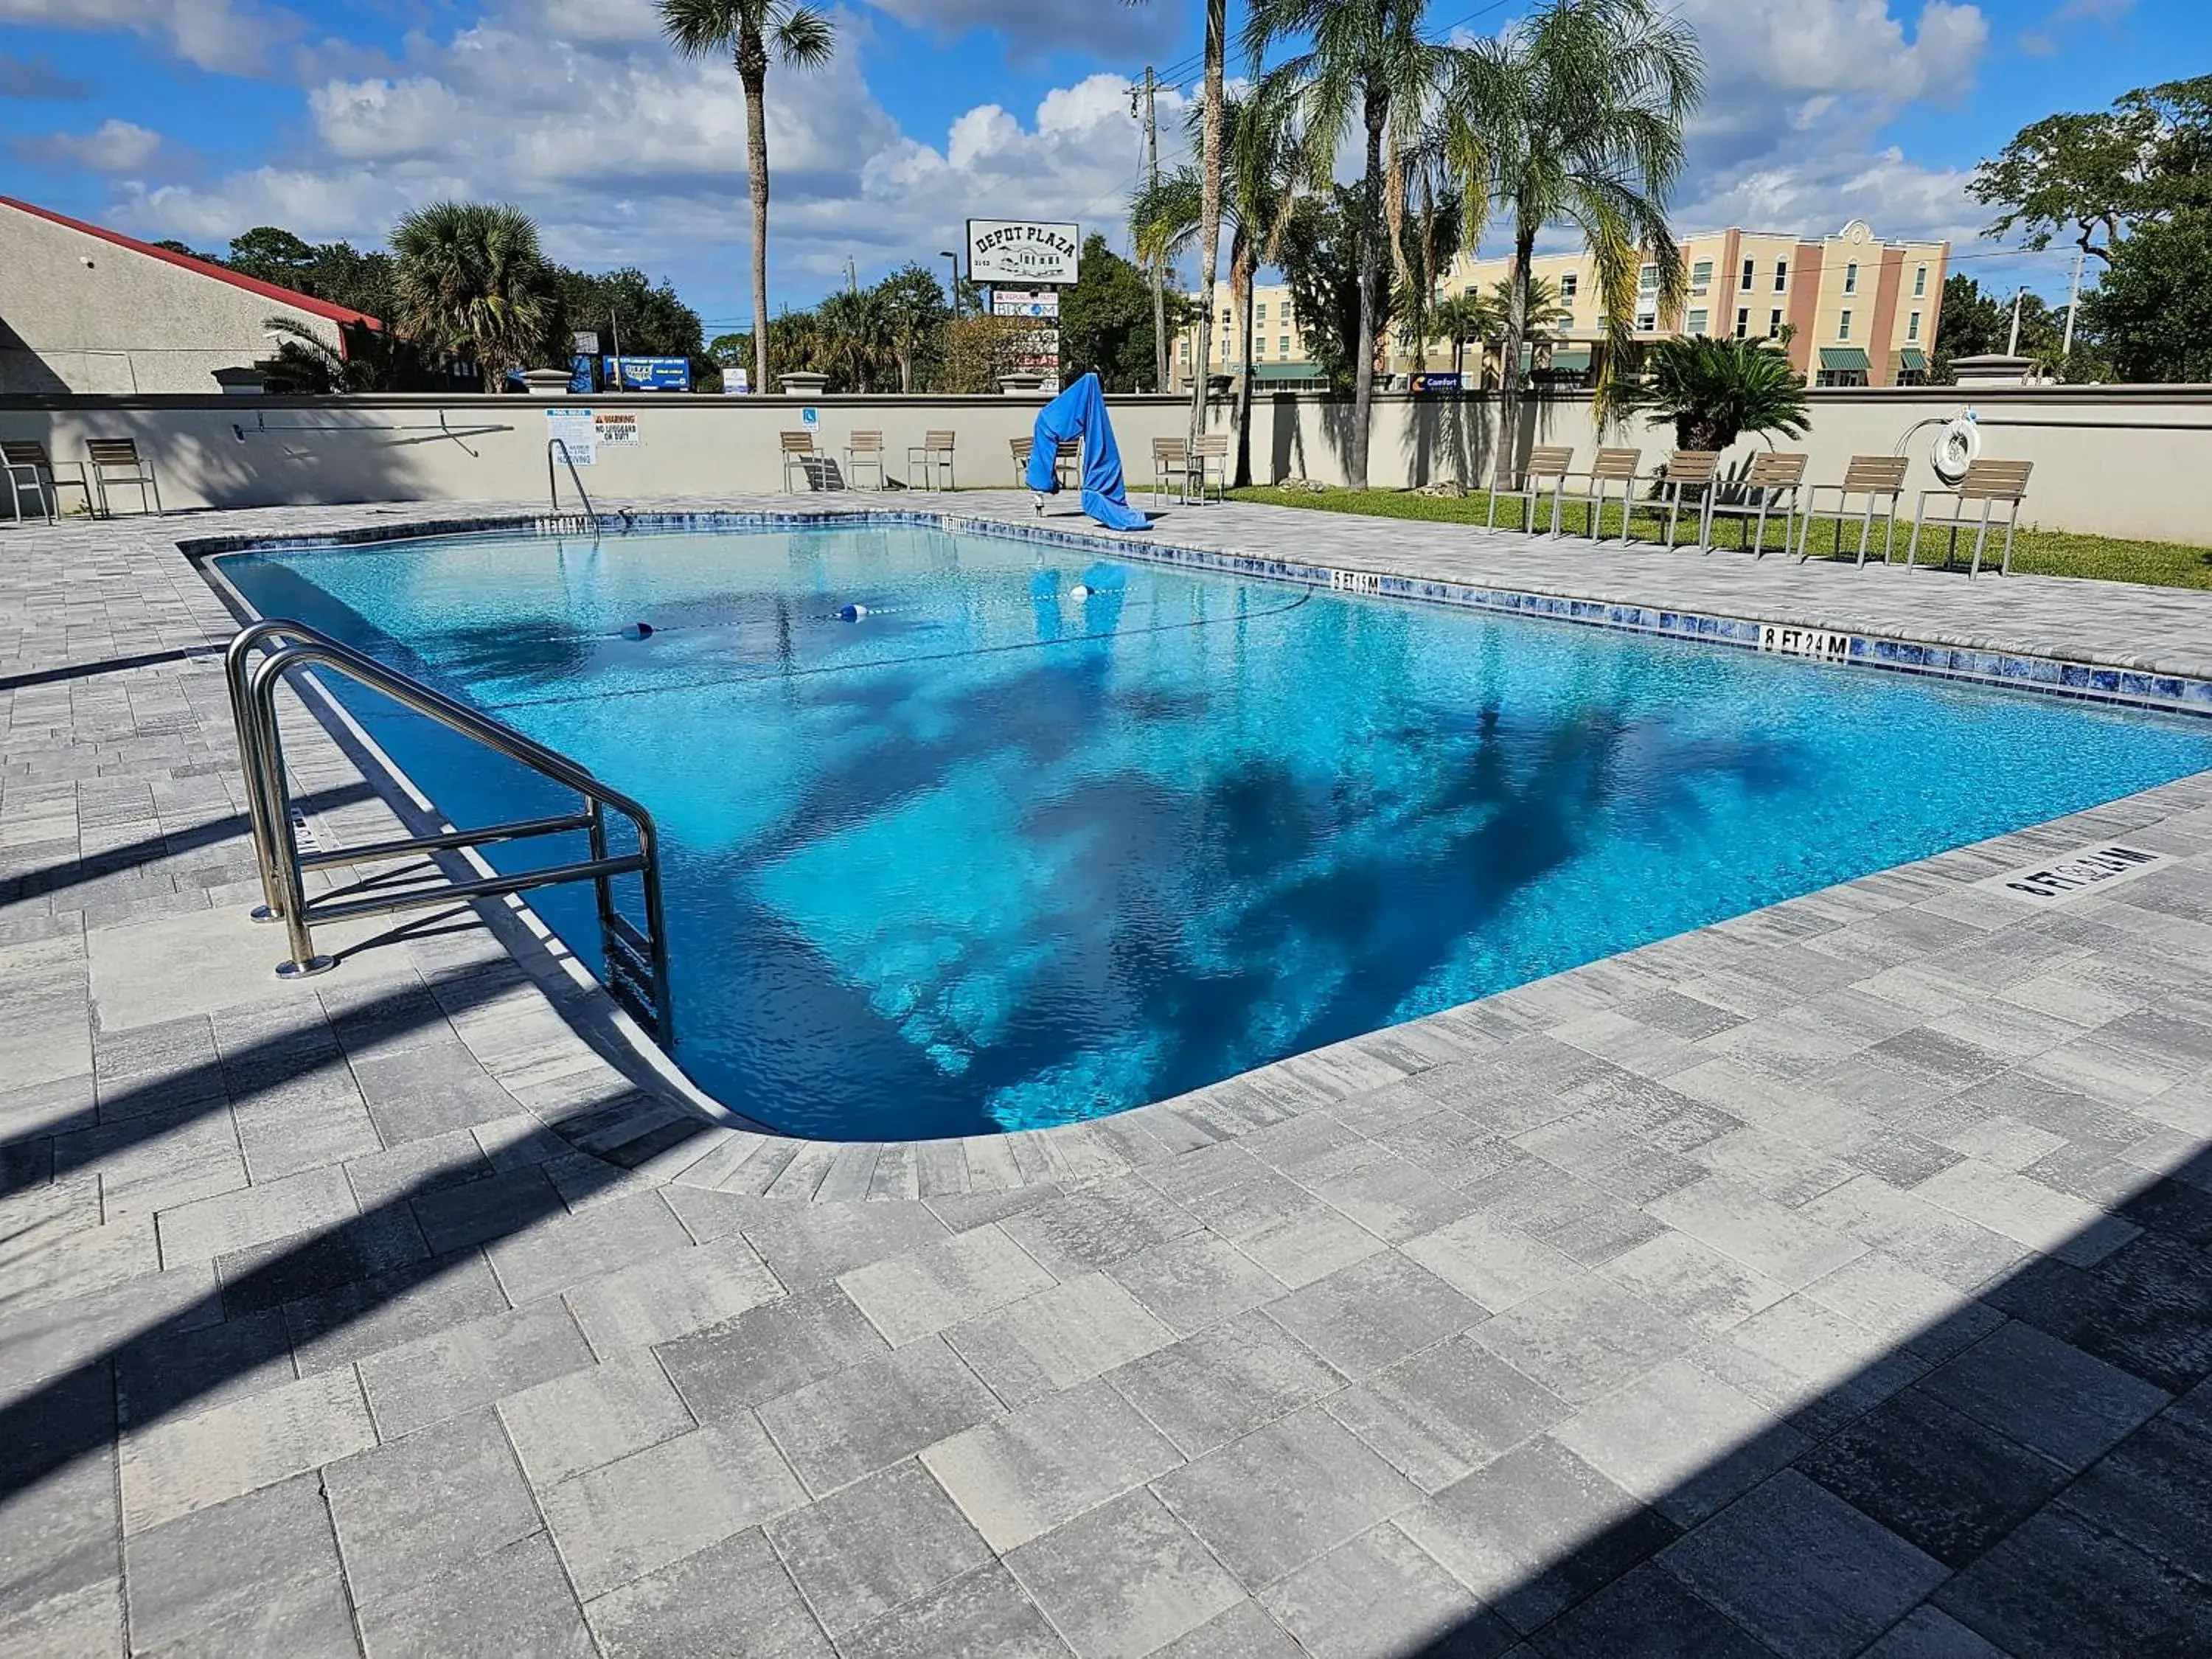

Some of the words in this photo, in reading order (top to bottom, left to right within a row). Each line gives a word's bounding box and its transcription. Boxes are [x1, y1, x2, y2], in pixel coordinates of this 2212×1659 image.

[975, 226, 1023, 253] DEPOT
[1027, 227, 1075, 257] PLAZA
[604, 414, 635, 423] WARNING
[1765, 628, 1775, 644] 8
[1782, 630, 1803, 647] FT
[1829, 636, 1847, 654] M
[2006, 883, 2056, 896] 8
[2023, 871, 2087, 890] FT
